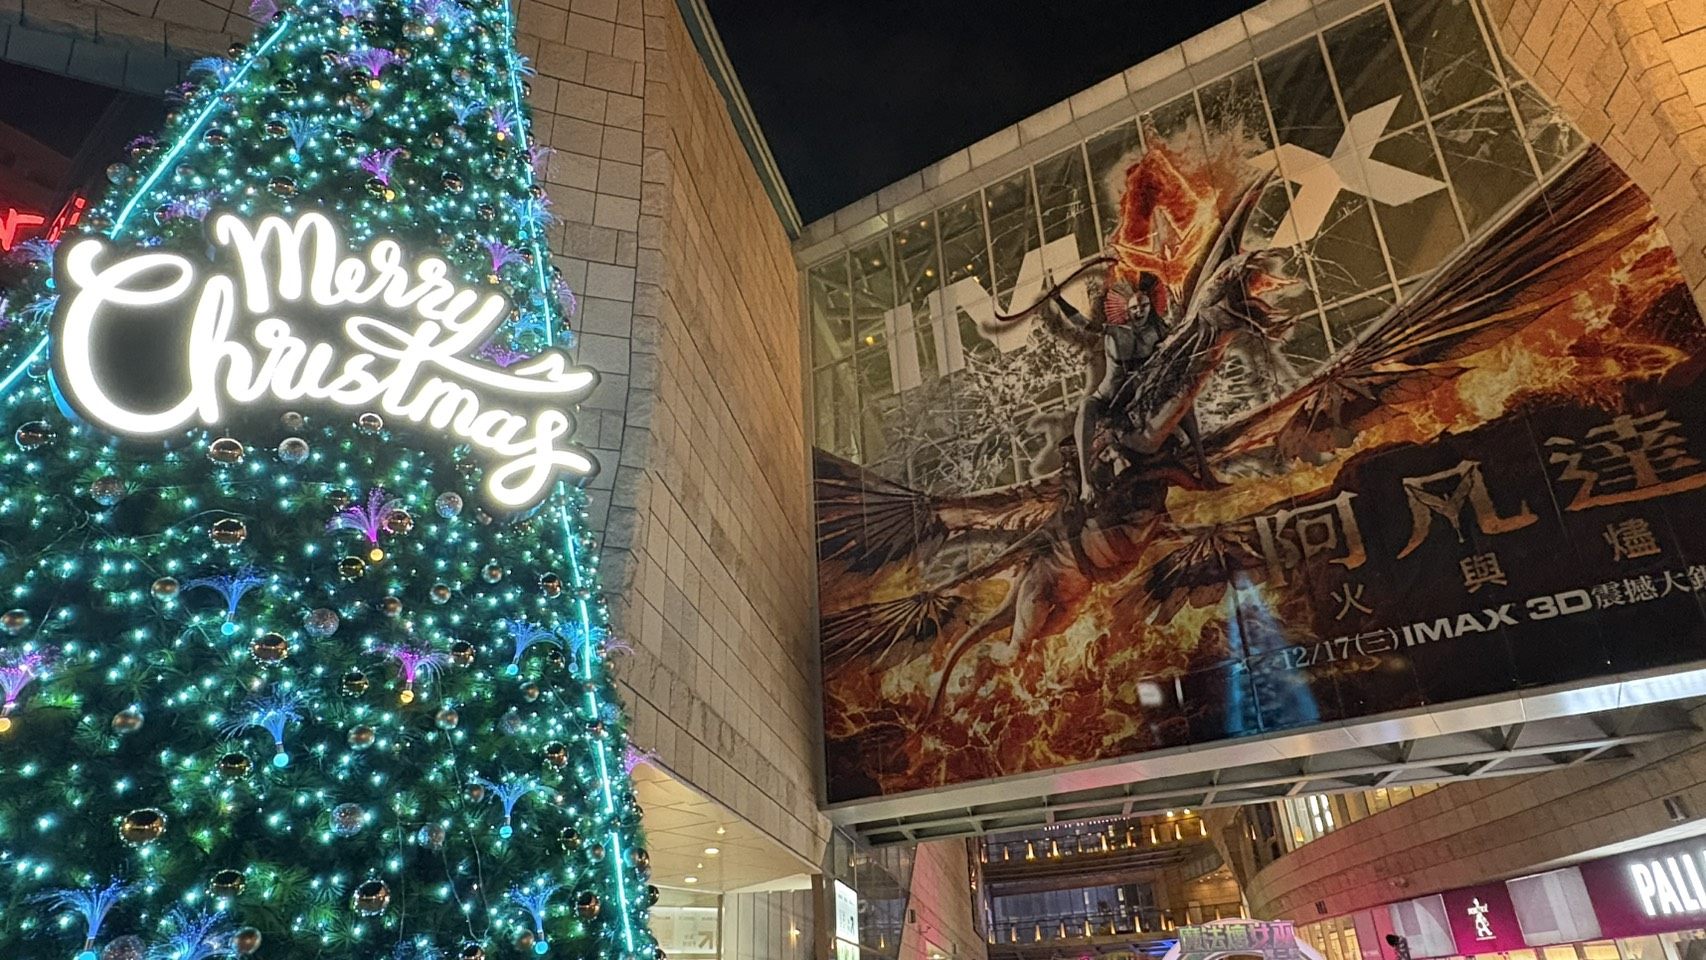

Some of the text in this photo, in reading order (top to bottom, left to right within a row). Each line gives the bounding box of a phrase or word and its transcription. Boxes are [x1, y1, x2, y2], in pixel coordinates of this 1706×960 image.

[216, 212, 505, 350] Merry
[62, 239, 594, 506] Christmas
[1255, 410, 1706, 588] 阿凡達
[1330, 518, 1661, 621] 火與燼
[1403, 603, 1520, 647] IMAX
[1526, 589, 1593, 620] 3D
[1630, 849, 1706, 916] PALL
